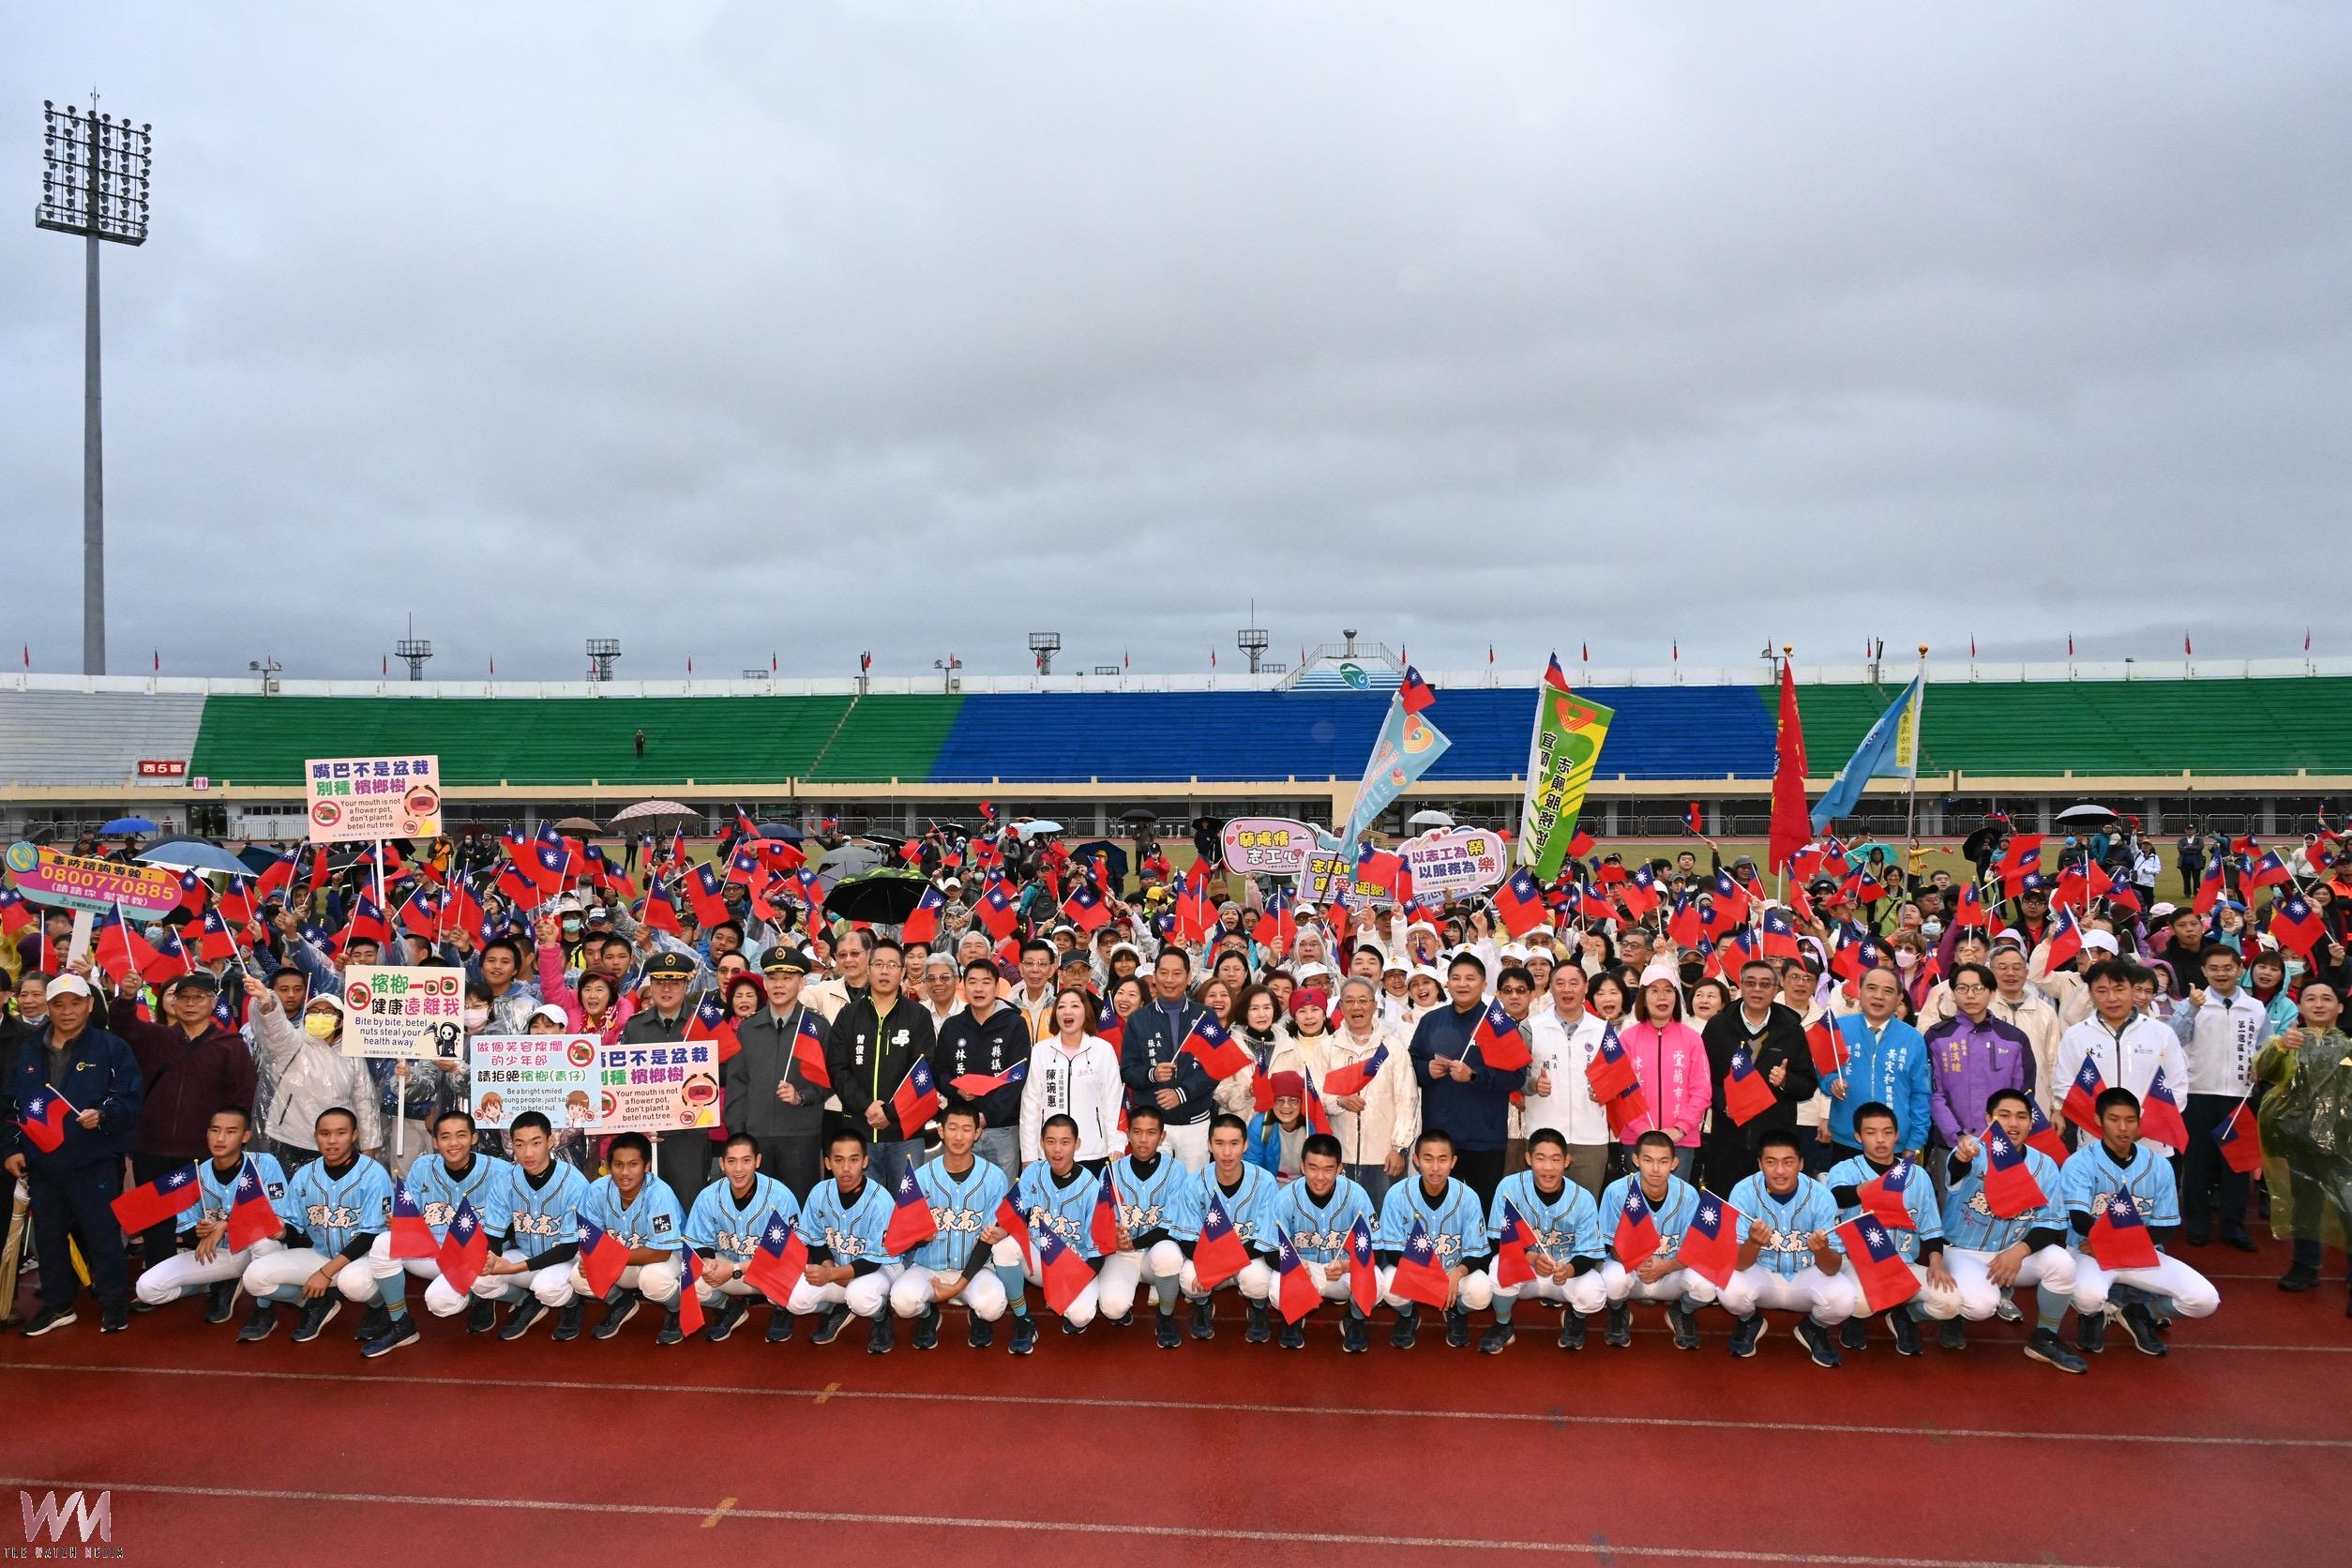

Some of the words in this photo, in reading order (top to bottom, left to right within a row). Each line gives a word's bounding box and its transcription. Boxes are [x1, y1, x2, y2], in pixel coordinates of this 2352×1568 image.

[312, 759, 430, 779] 嘴巴不是盆栽
[315, 779, 351, 796] 別種
[354, 777, 406, 795] 檳榔樹
[358, 798, 381, 807] mouth
[378, 807, 393, 815] pot,
[369, 814, 387, 822] plant
[1247, 848, 1300, 864] 志工心
[1411, 838, 1485, 865] 以志工為榮
[1418, 856, 1495, 879] 以服務為樂
[40, 866, 174, 900] 0800770885
[371, 997, 460, 1016] 健康遠離我
[354, 1017, 372, 1025] Bite
[373, 1018, 384, 1026] by
[384, 1018, 403, 1027] bite,
[406, 1018, 428, 1027] betel
[476, 1041, 563, 1053] 做個笑容燦爛
[491, 1055, 548, 1066] 的少年郎
[955, 1048, 967, 1078] 林岳
[477, 1069, 586, 1082] 請拒絕檳榔(青仔)
[630, 1065, 684, 1084] 檳榔樹
[634, 1089, 657, 1097] mouth
[654, 1096, 670, 1105] pot,
[626, 1105, 644, 1113] don't
